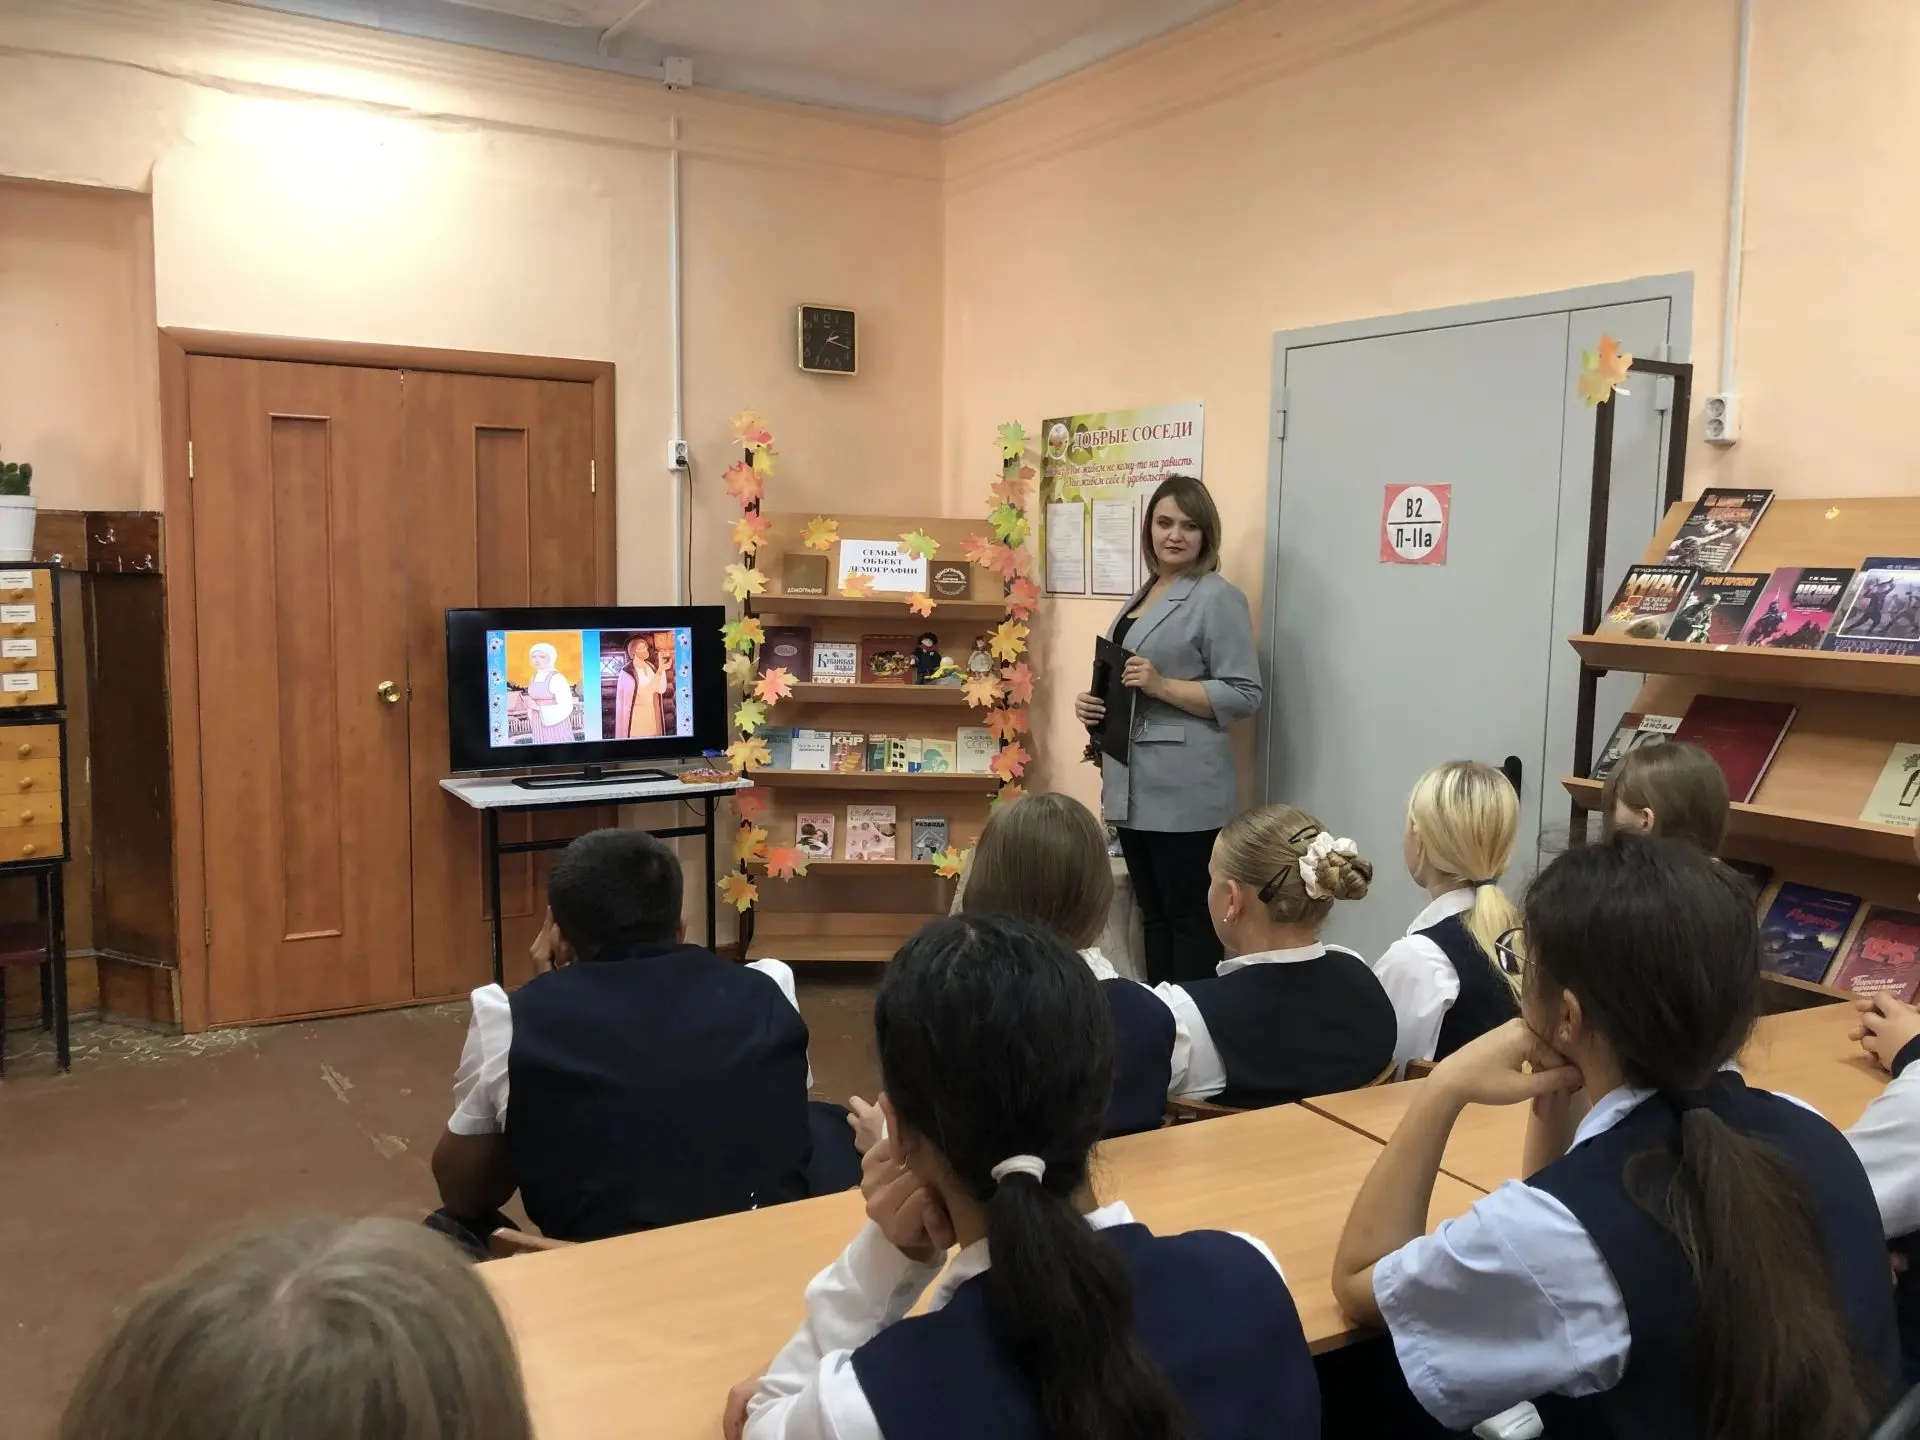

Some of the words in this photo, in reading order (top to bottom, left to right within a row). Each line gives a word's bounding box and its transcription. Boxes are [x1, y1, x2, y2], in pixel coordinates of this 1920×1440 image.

[1072, 428, 1129, 451] ДОБРЫЕ
[1132, 421, 1193, 442] СОСЕДИ
[1149, 460, 1159, 469] на
[1406, 498, 1423, 518] В2
[862, 549, 898, 557] СЕМЬЯ
[863, 558, 903, 566] ОБЪЕКТ
[848, 566, 918, 575] ДЕМОГРАФИИ
[1795, 584, 1842, 596] ВЕРНЫЕ
[832, 736, 864, 746] КНР
